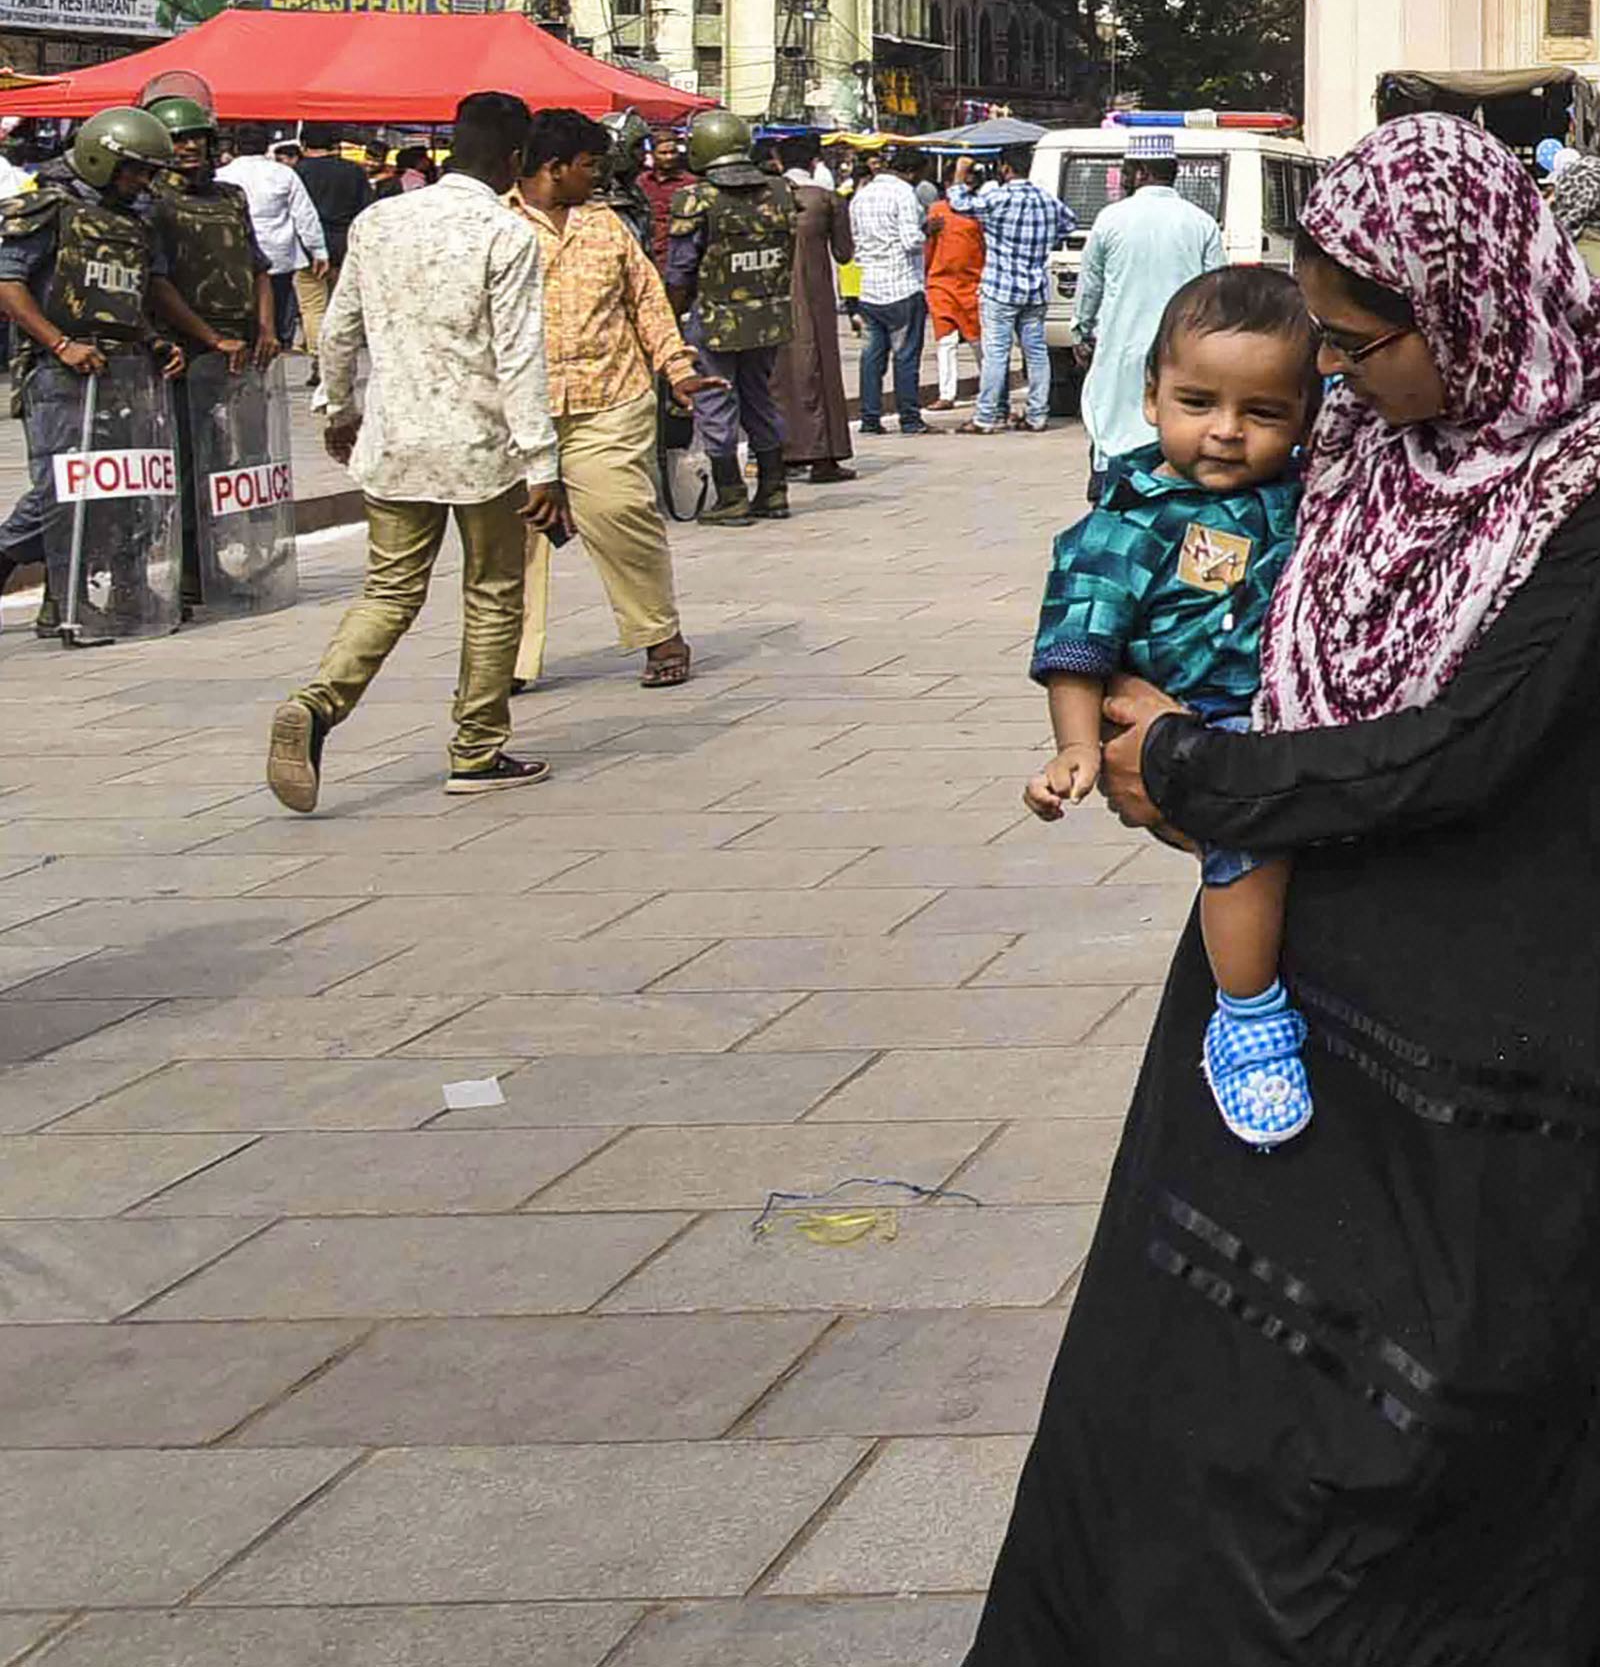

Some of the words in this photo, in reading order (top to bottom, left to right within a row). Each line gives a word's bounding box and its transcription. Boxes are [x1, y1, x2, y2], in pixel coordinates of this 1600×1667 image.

[731, 248, 782, 273] POLICE
[67, 456, 173, 494] POLICE
[215, 464, 289, 511] POLICE
